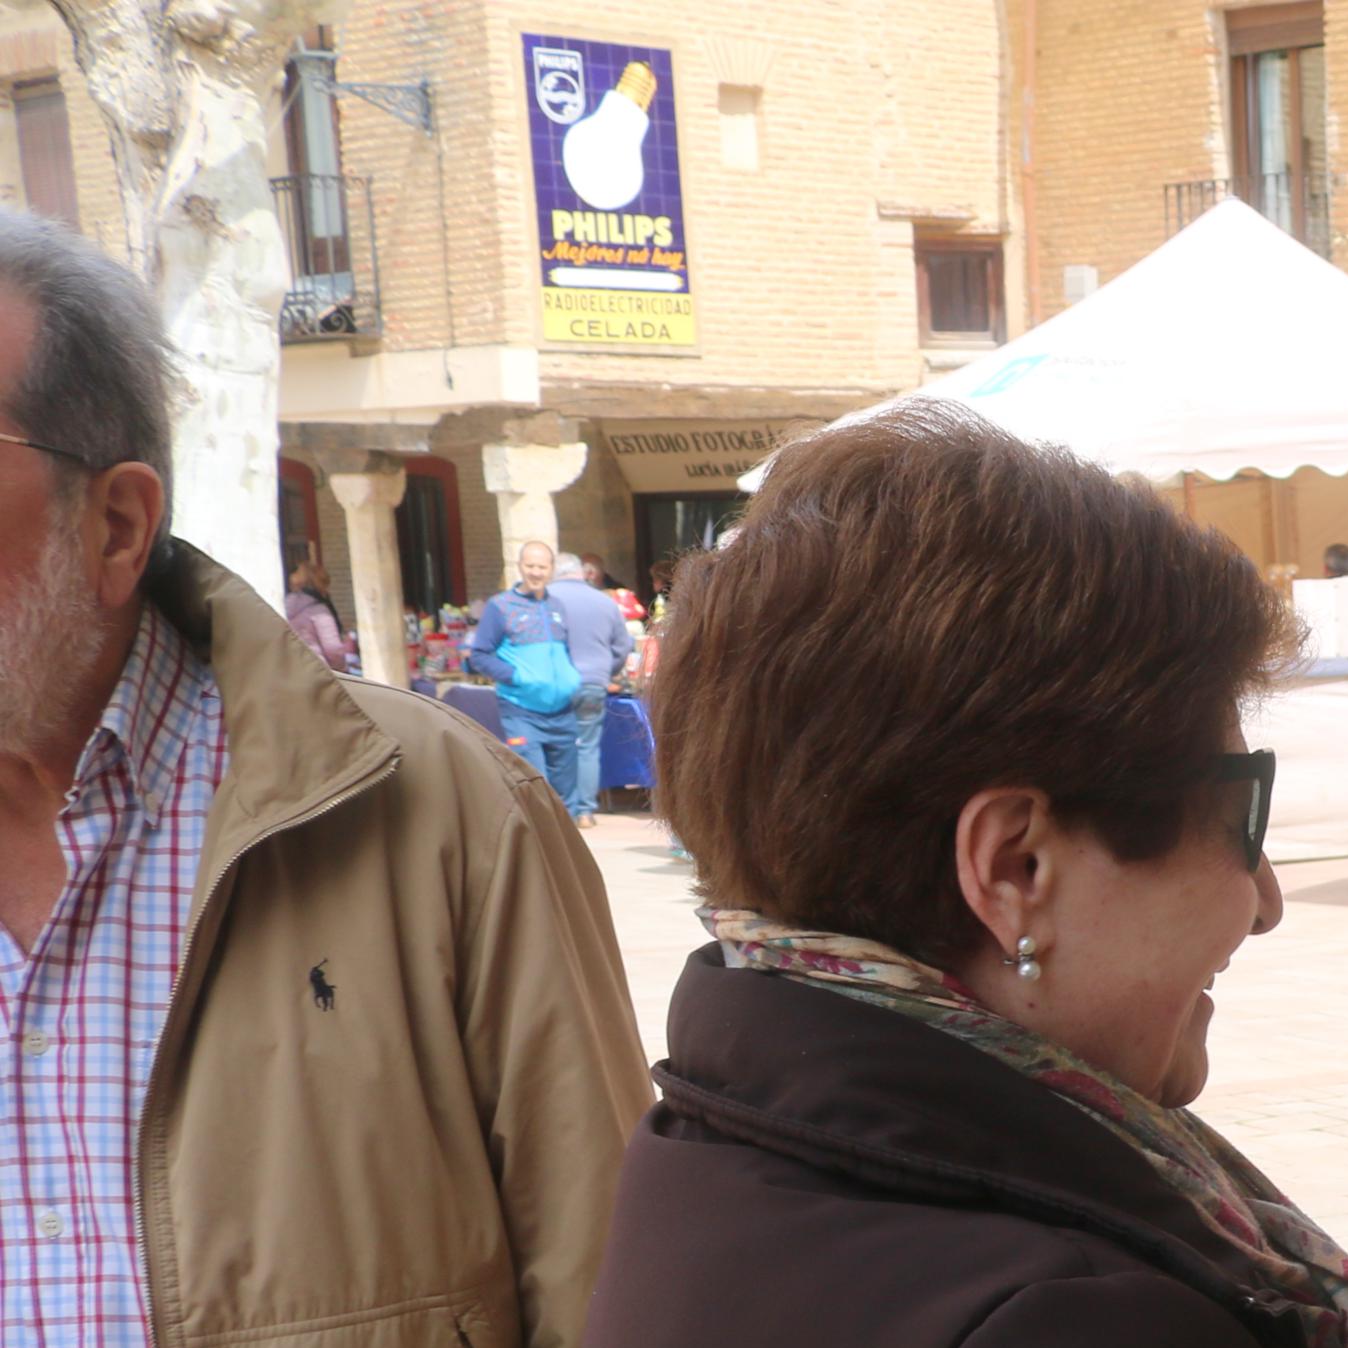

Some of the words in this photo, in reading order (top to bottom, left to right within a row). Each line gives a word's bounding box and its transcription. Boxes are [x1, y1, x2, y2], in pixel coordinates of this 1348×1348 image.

[538, 54, 578, 71] PHILIPS
[552, 209, 673, 247] PHILIPS
[542, 240, 624, 266] Mejores
[544, 292, 691, 316] RADIOELECTRICIDAD
[569, 319, 672, 340] CELADA
[610, 432, 689, 454] ESTUDIO
